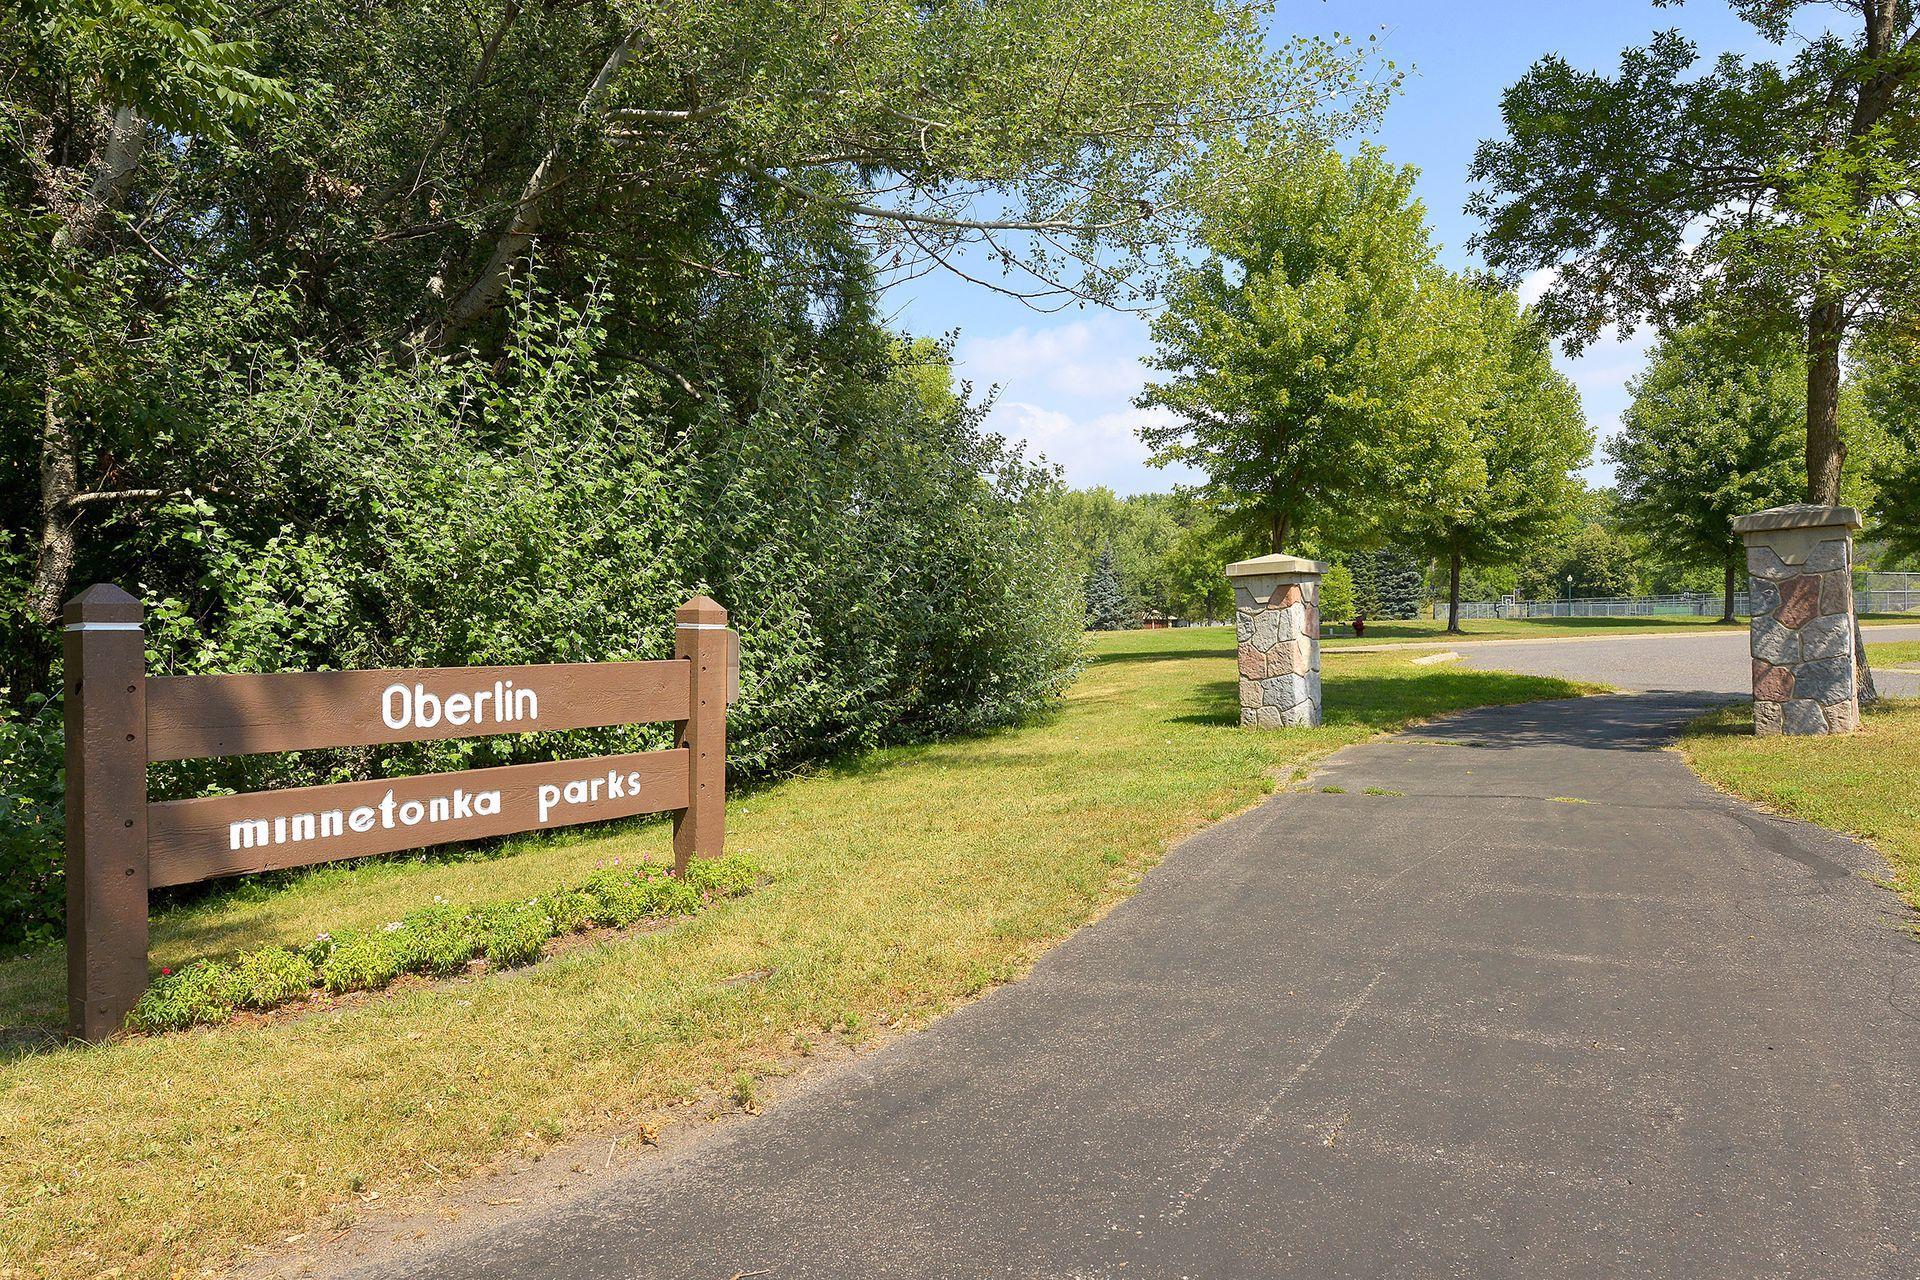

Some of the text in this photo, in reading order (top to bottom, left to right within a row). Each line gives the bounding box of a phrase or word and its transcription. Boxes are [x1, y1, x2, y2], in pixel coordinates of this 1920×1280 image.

[381, 679, 539, 730] Oberlin
[228, 769, 642, 851] minnetonka parks
